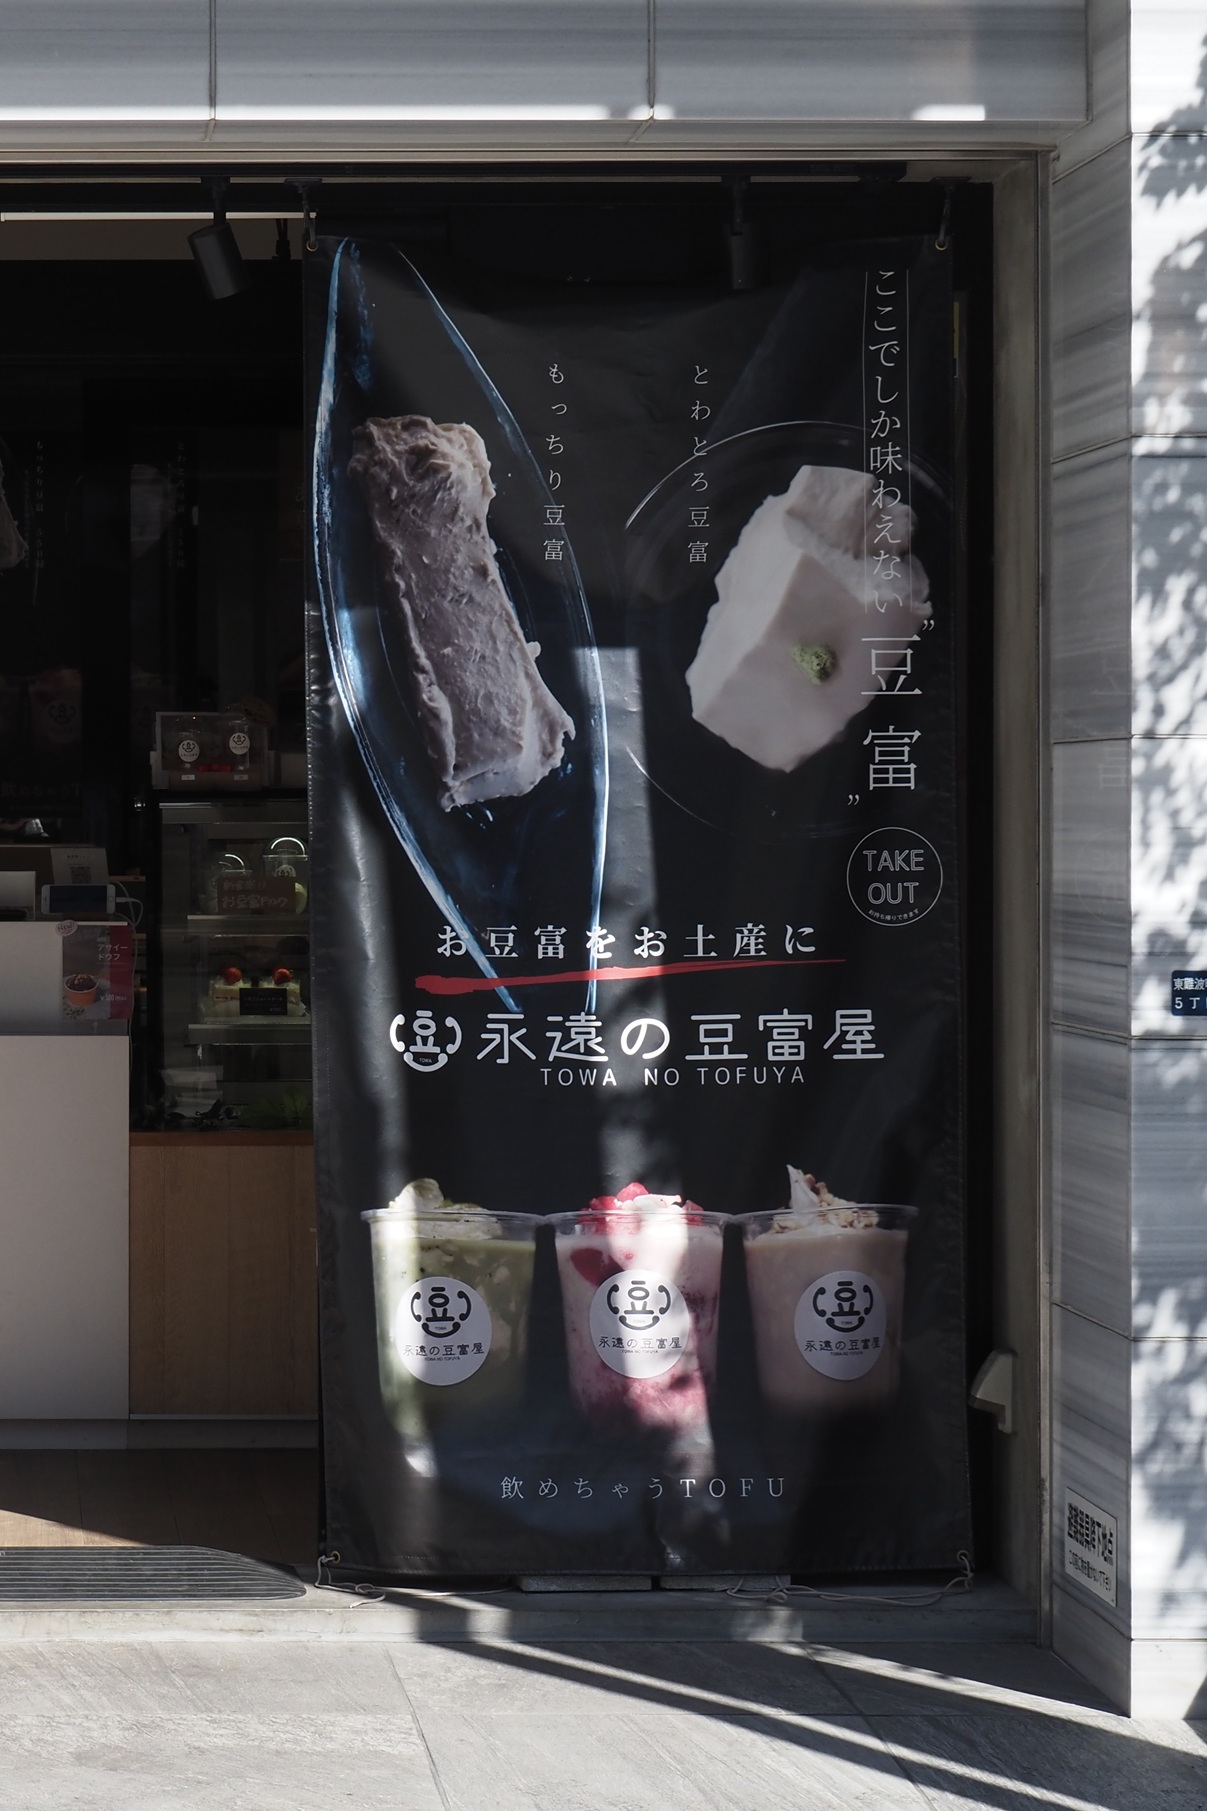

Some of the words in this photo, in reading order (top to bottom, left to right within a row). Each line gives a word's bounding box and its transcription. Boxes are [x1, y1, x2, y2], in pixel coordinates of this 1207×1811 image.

[868, 270, 904, 616] ここでしか味わえない
[543, 363, 566, 563] もっちり豆富
[687, 364, 711, 565] とわとろ豆富
[862, 849, 925, 871] TAKE
[867, 882, 920, 905] OUT
[868, 908, 920, 921] お持ち帰りできます
[436, 922, 817, 960] お豆富をお土産に
[1173, 977, 1207, 990] 東難波
[1175, 996, 1207, 1010] 5丁
[476, 1008, 884, 1064] 永遠の豆富屋
[540, 1068, 617, 1088] TOWA
[644, 1068, 680, 1087] NO
[696, 1065, 805, 1086] TOFUYA
[403, 1342, 484, 1356] 永遠の豆富屋
[598, 1336, 682, 1349] 永遠の豆富屋
[804, 1336, 881, 1352] 永遠の豆富屋
